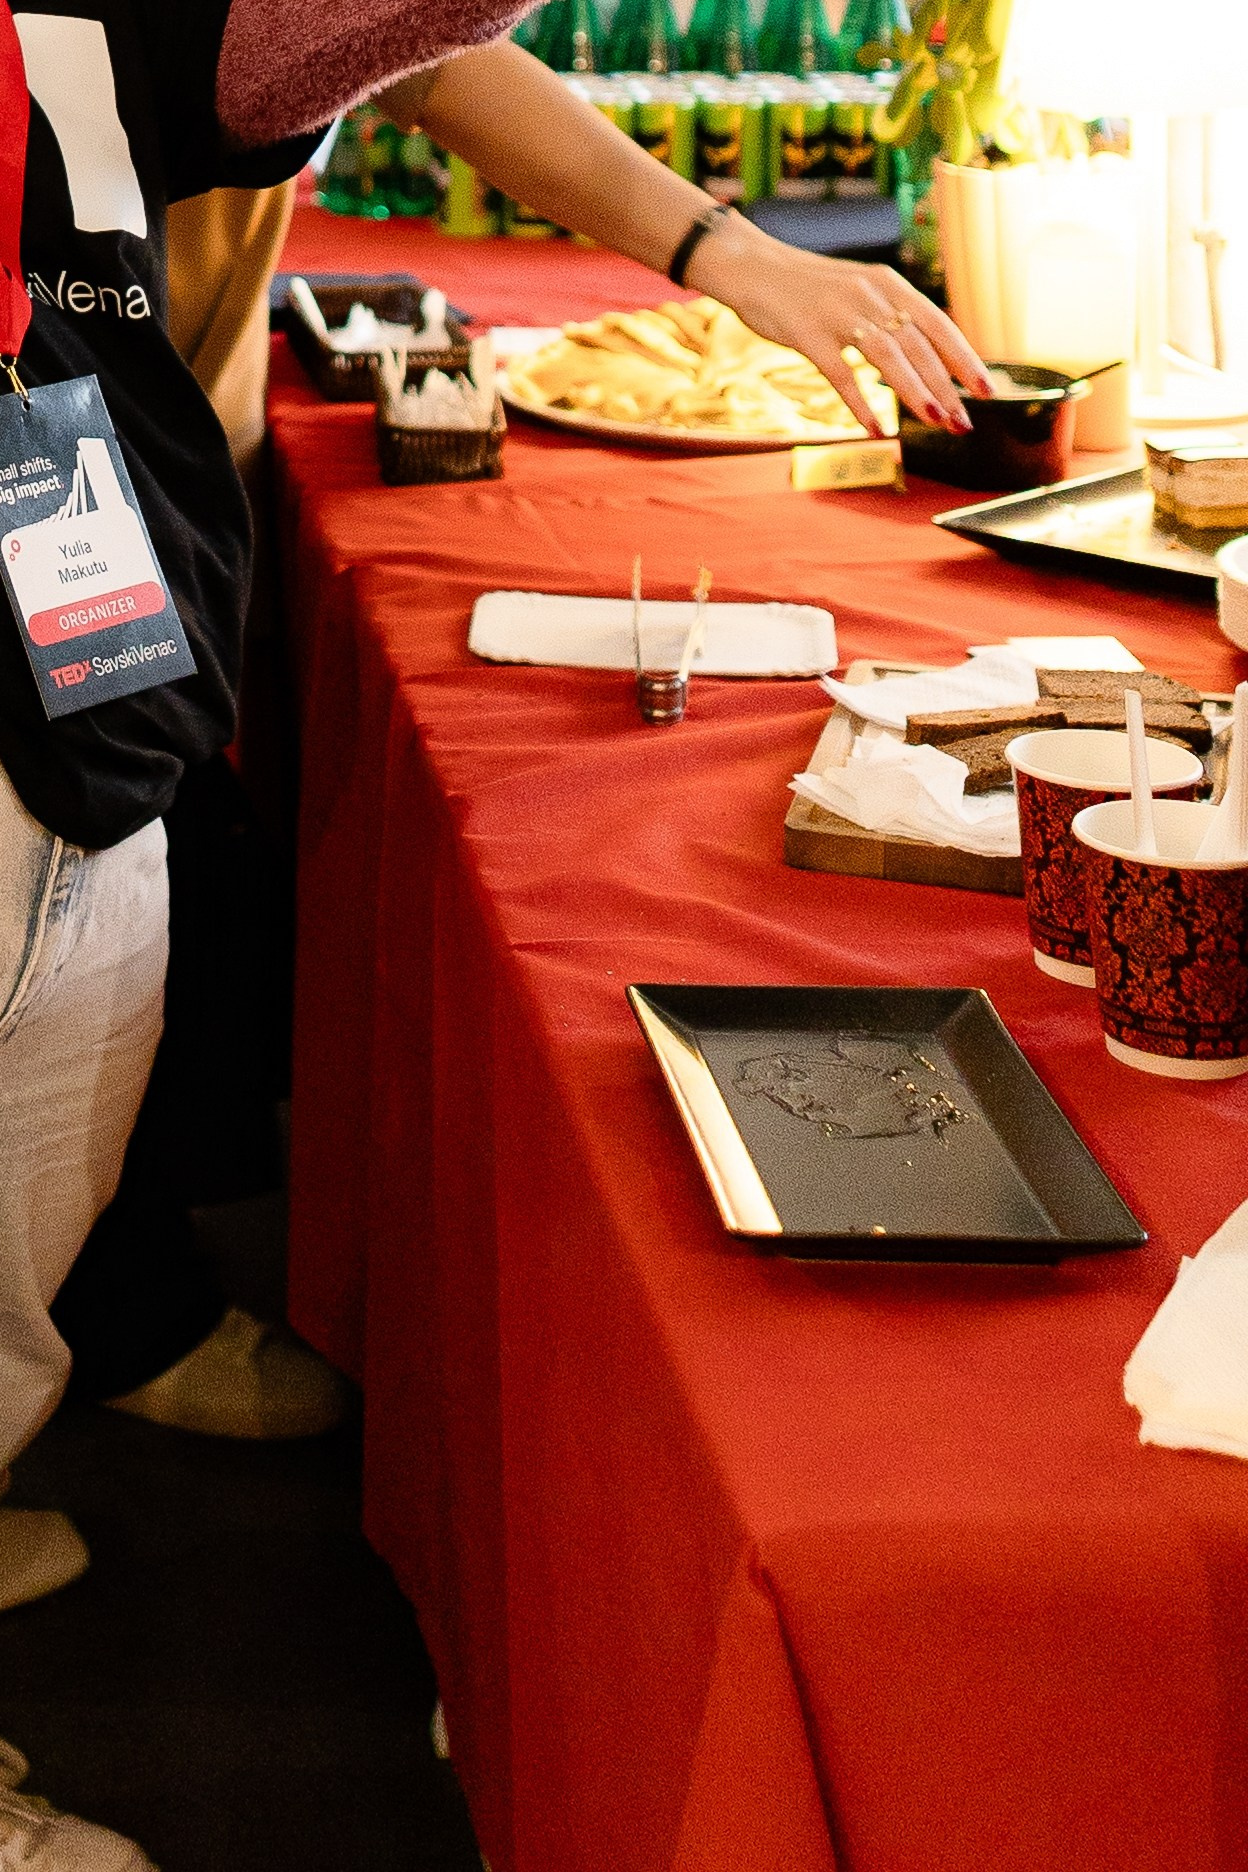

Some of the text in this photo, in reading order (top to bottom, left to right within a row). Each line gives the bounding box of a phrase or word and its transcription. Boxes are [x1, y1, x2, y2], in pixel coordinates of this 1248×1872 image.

[57, 539, 93, 560] Yulia
[57, 561, 109, 584] Makutu
[58, 595, 137, 631] ORGANIZER
